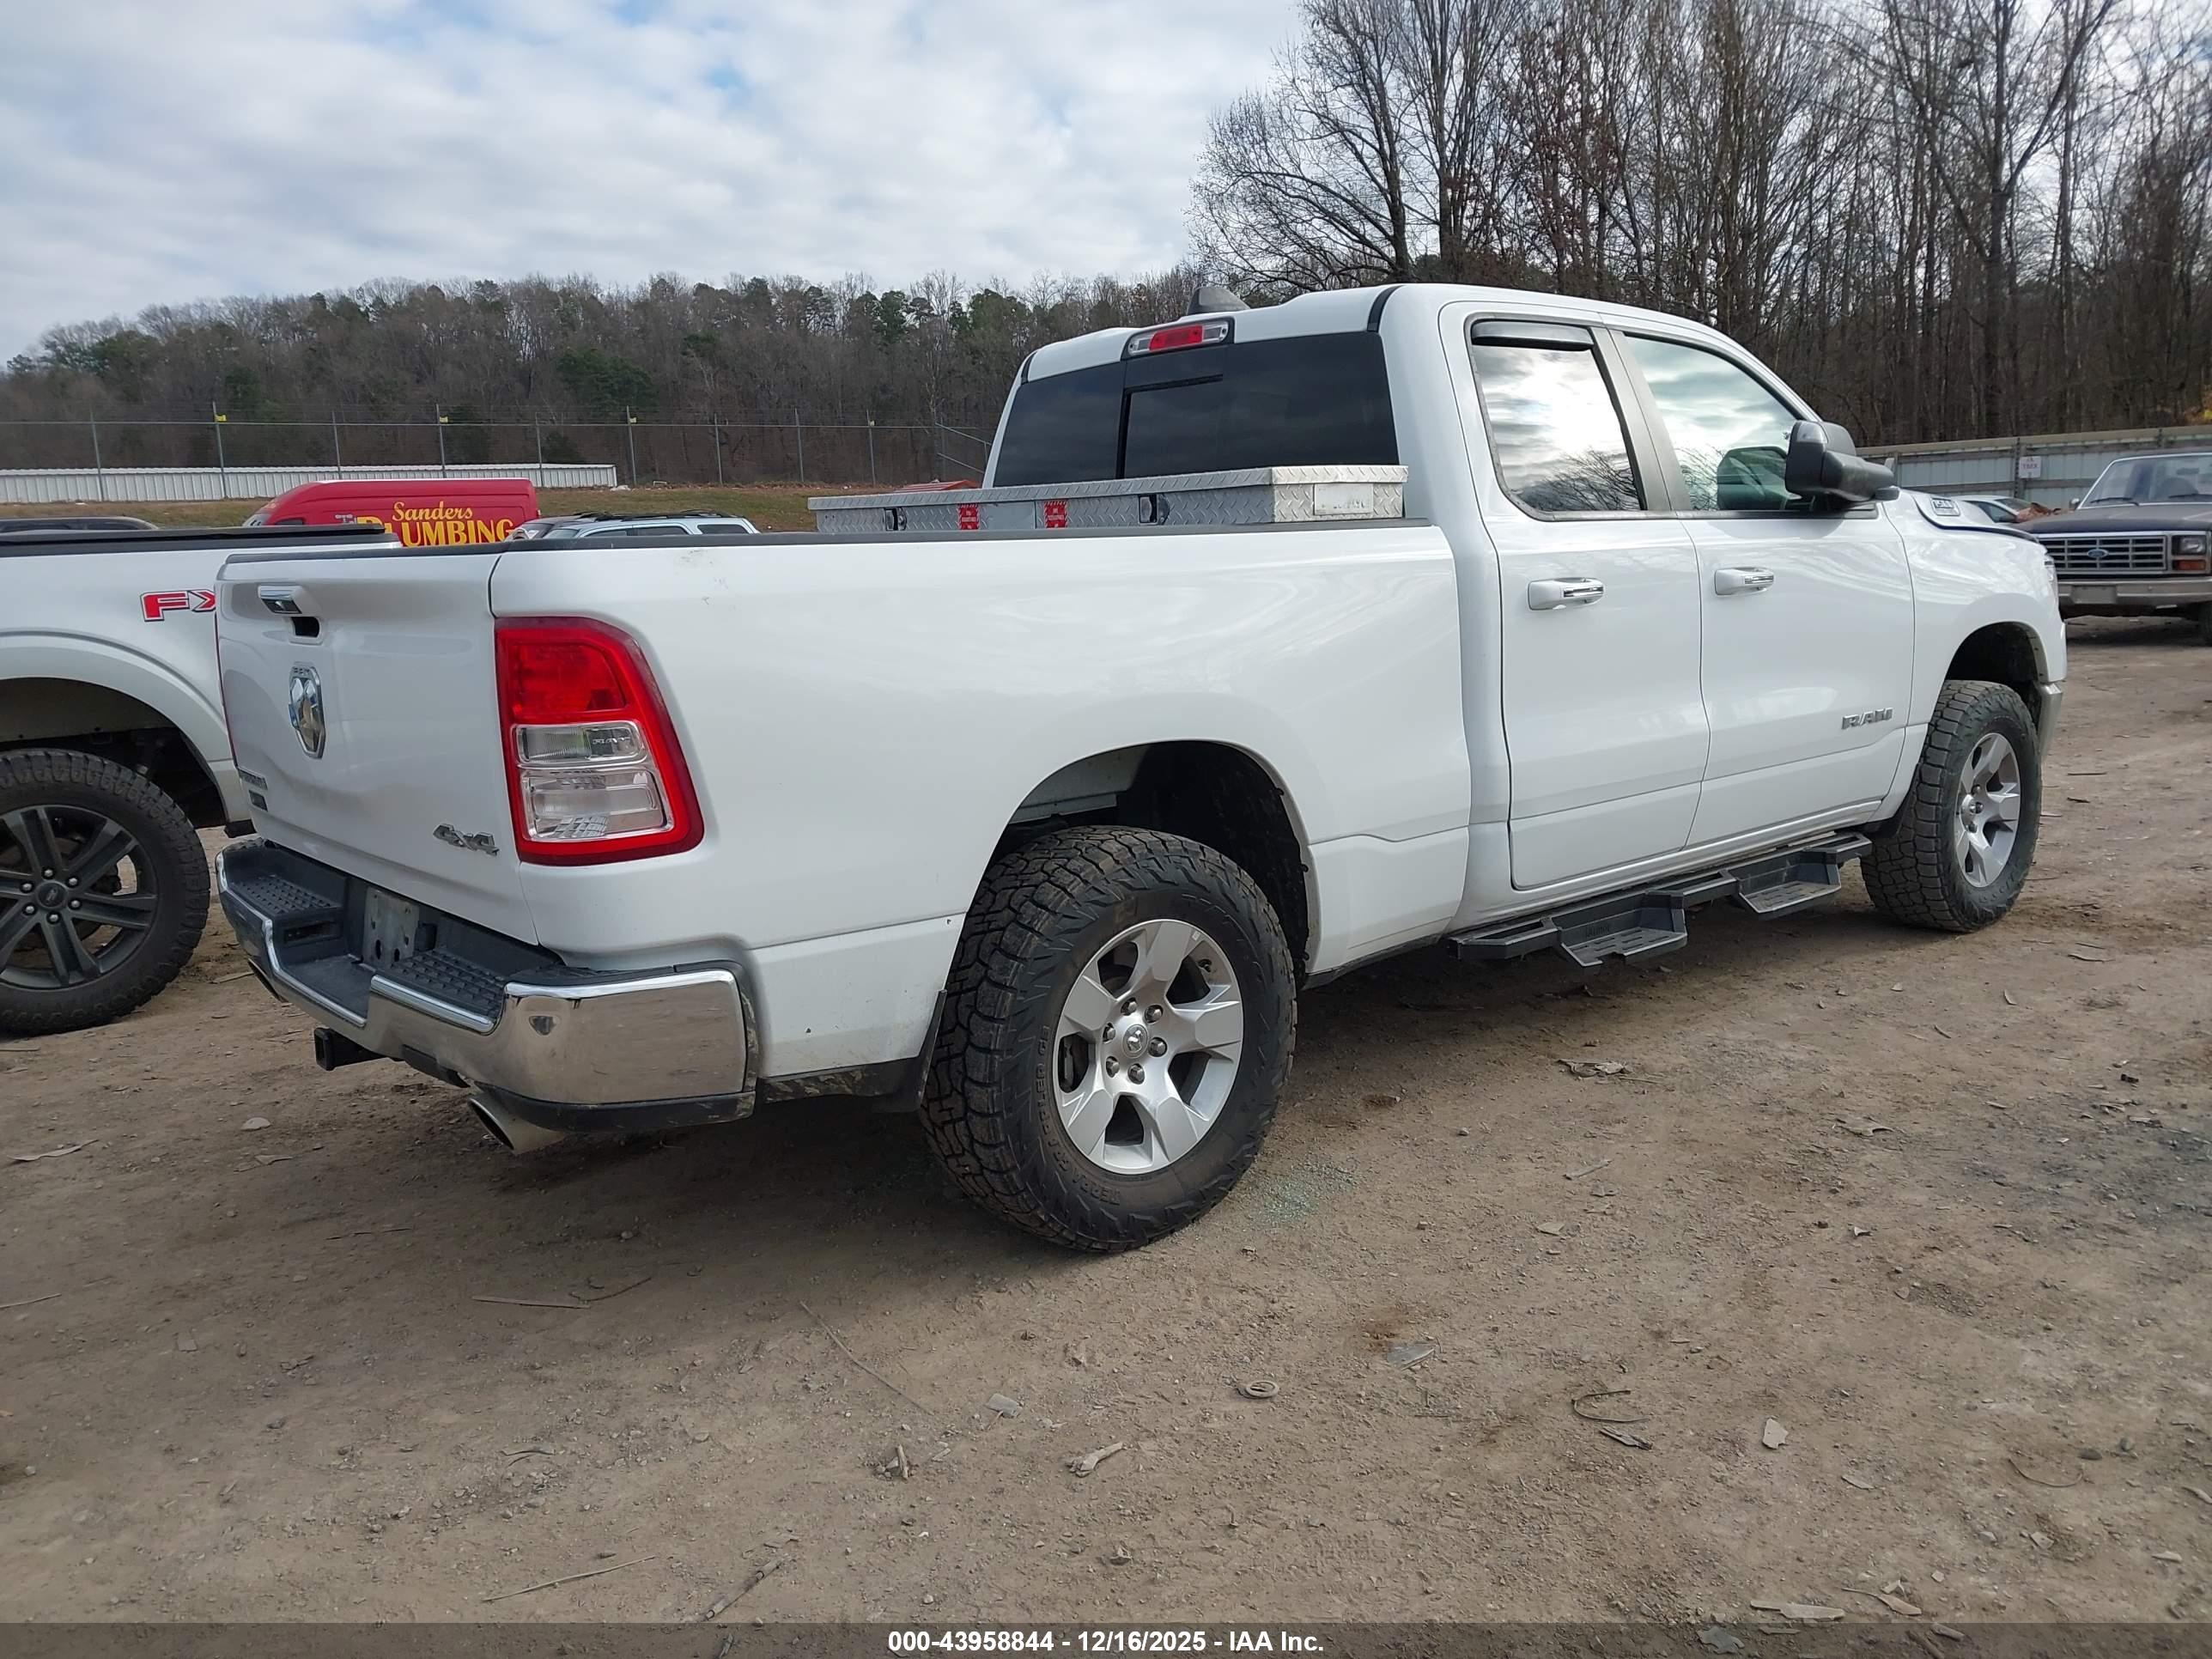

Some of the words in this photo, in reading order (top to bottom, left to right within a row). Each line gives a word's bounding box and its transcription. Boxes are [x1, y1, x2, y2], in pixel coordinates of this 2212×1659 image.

[392, 501, 472, 521] Sanders
[357, 517, 515, 547] UMBING
[1841, 708, 1893, 729] RAM
